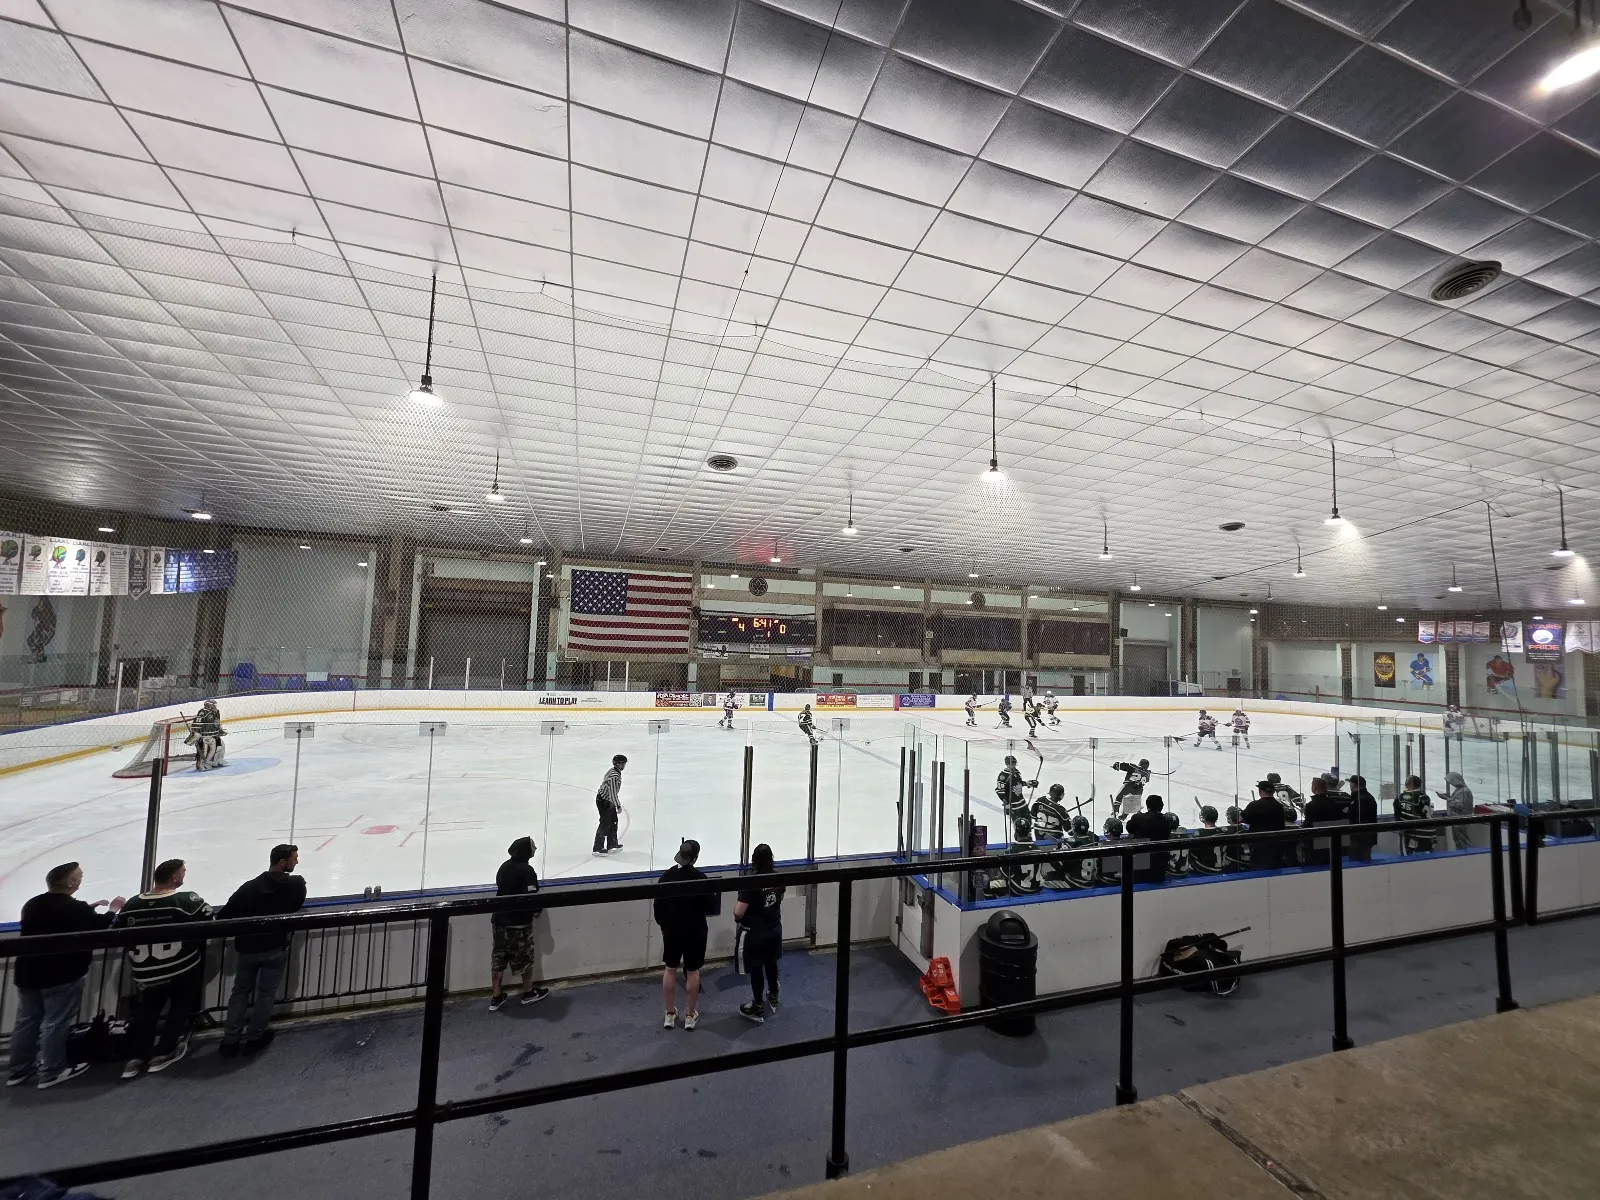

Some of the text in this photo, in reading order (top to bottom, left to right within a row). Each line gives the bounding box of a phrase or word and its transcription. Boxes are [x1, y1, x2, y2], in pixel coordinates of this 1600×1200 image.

[753, 617, 772, 628] 6:41
[738, 623, 745, 632] 4
[780, 624, 786, 634] 0
[539, 696, 556, 705] LEARN
[557, 697, 564, 705] TO
[565, 697, 577, 705] PLAY
